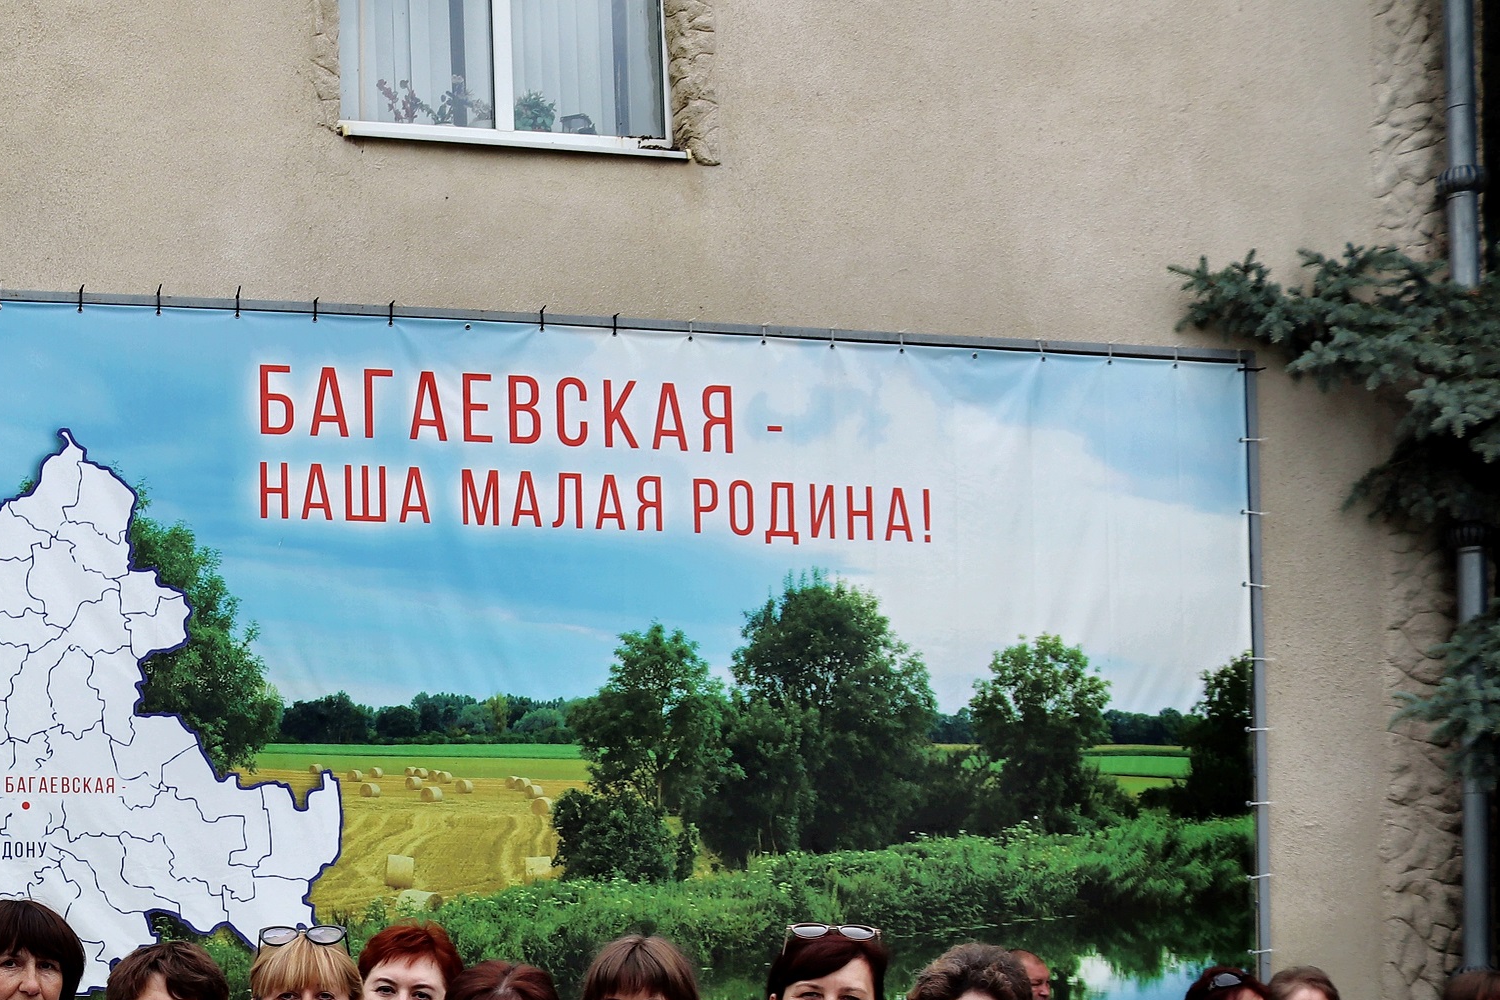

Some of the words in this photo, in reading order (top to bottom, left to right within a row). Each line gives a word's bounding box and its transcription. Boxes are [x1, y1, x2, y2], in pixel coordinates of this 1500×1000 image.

[258, 363, 734, 455] БАГАЕВСКАЯ
[258, 461, 432, 525] НАША
[460, 468, 665, 533] МАЛАЯ
[692, 478, 933, 546] РОДИНА!
[4, 776, 116, 794] БАГАЕВСКАЯ
